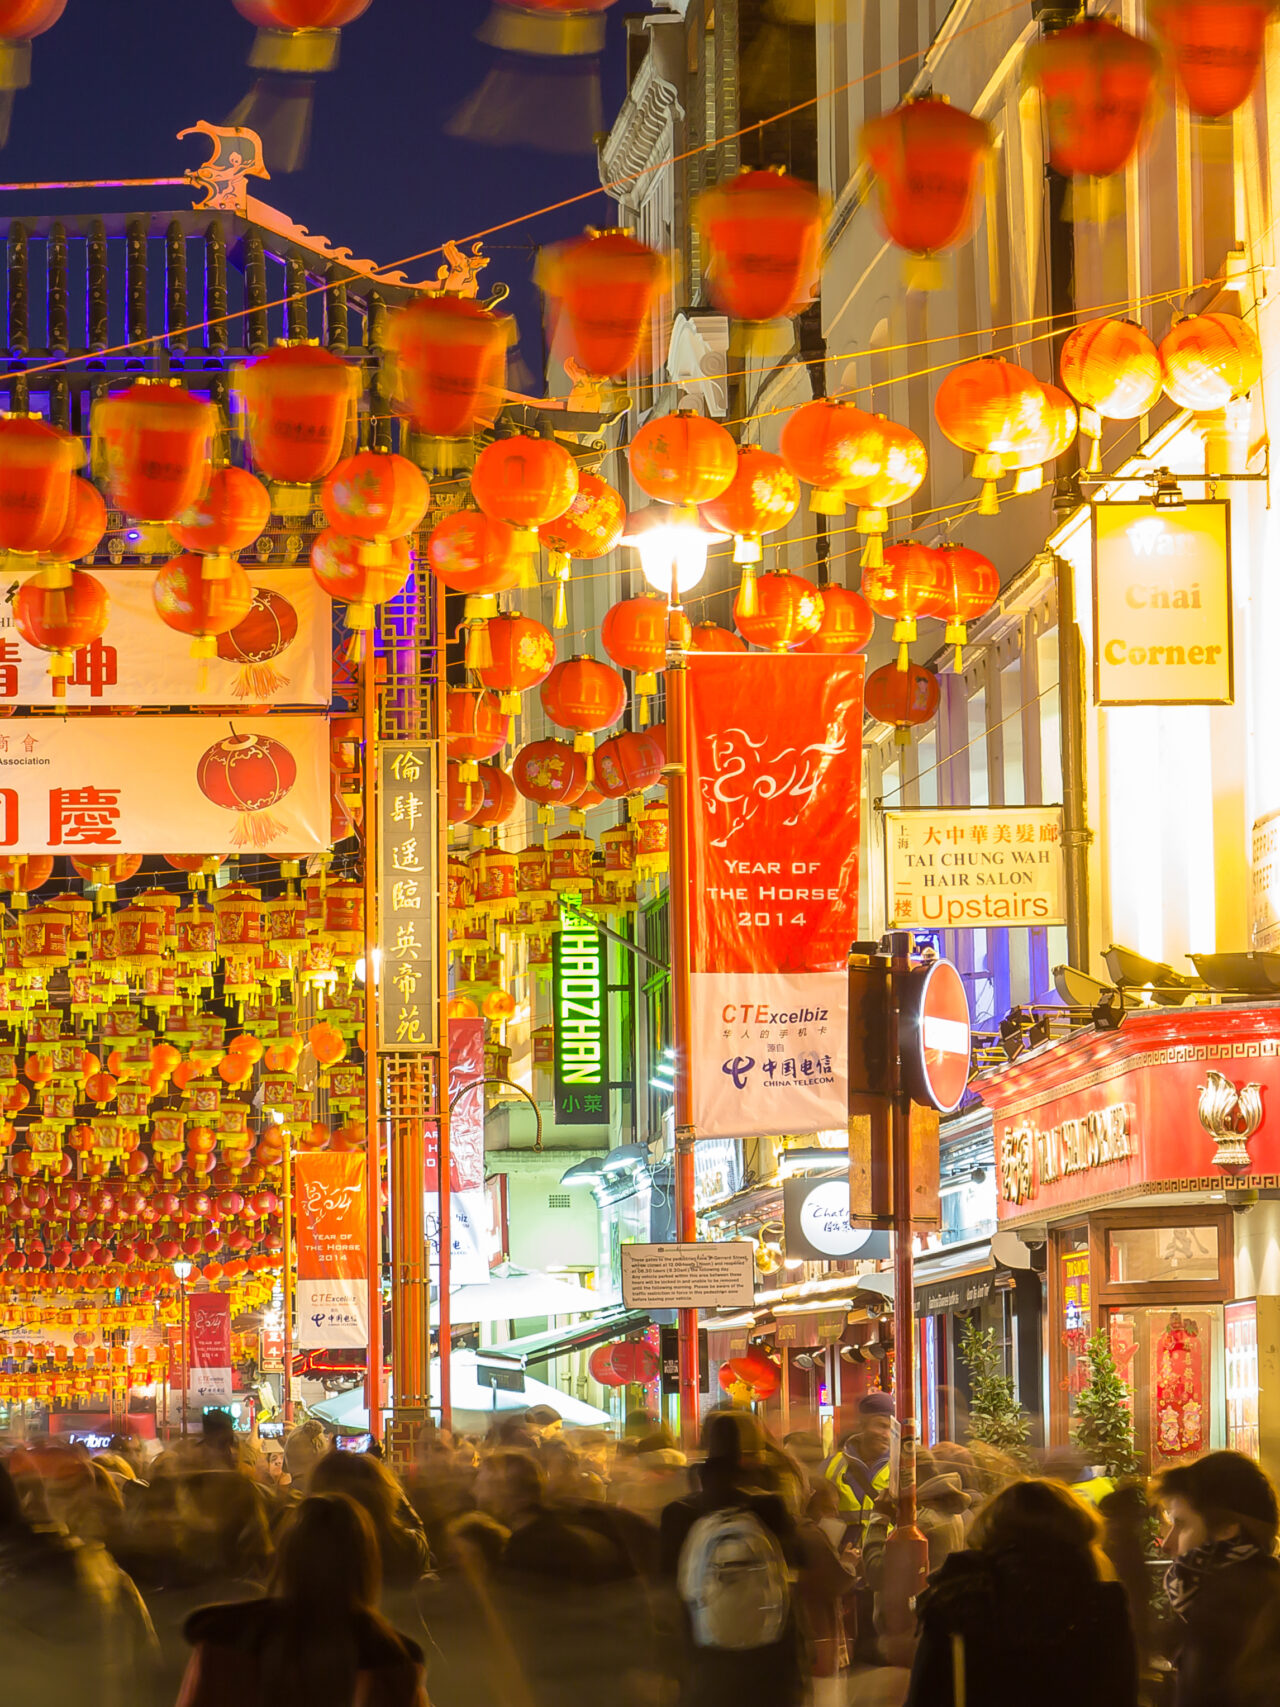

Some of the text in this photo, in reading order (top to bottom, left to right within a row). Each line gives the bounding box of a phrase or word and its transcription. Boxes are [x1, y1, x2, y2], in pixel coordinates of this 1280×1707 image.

[1125, 582, 1202, 609] Chai
[1104, 639, 1222, 666] Corner
[897, 825, 910, 850] 上海
[923, 823, 1059, 846] 大中華美髮廊
[724, 859, 821, 874] YEAR OF
[905, 850, 1051, 867] TAI CHUNG WAH
[924, 871, 1033, 888] HAIR SALON
[706, 886, 840, 900] THE HORSE
[894, 881, 913, 918] 二楼
[738, 912, 807, 927] 2014
[922, 892, 1049, 925] Upstairs
[721, 1003, 829, 1024] CTExcelbiz
[762, 1055, 833, 1080] 中国电信
[763, 1076, 835, 1088] CHINA TELECOM
